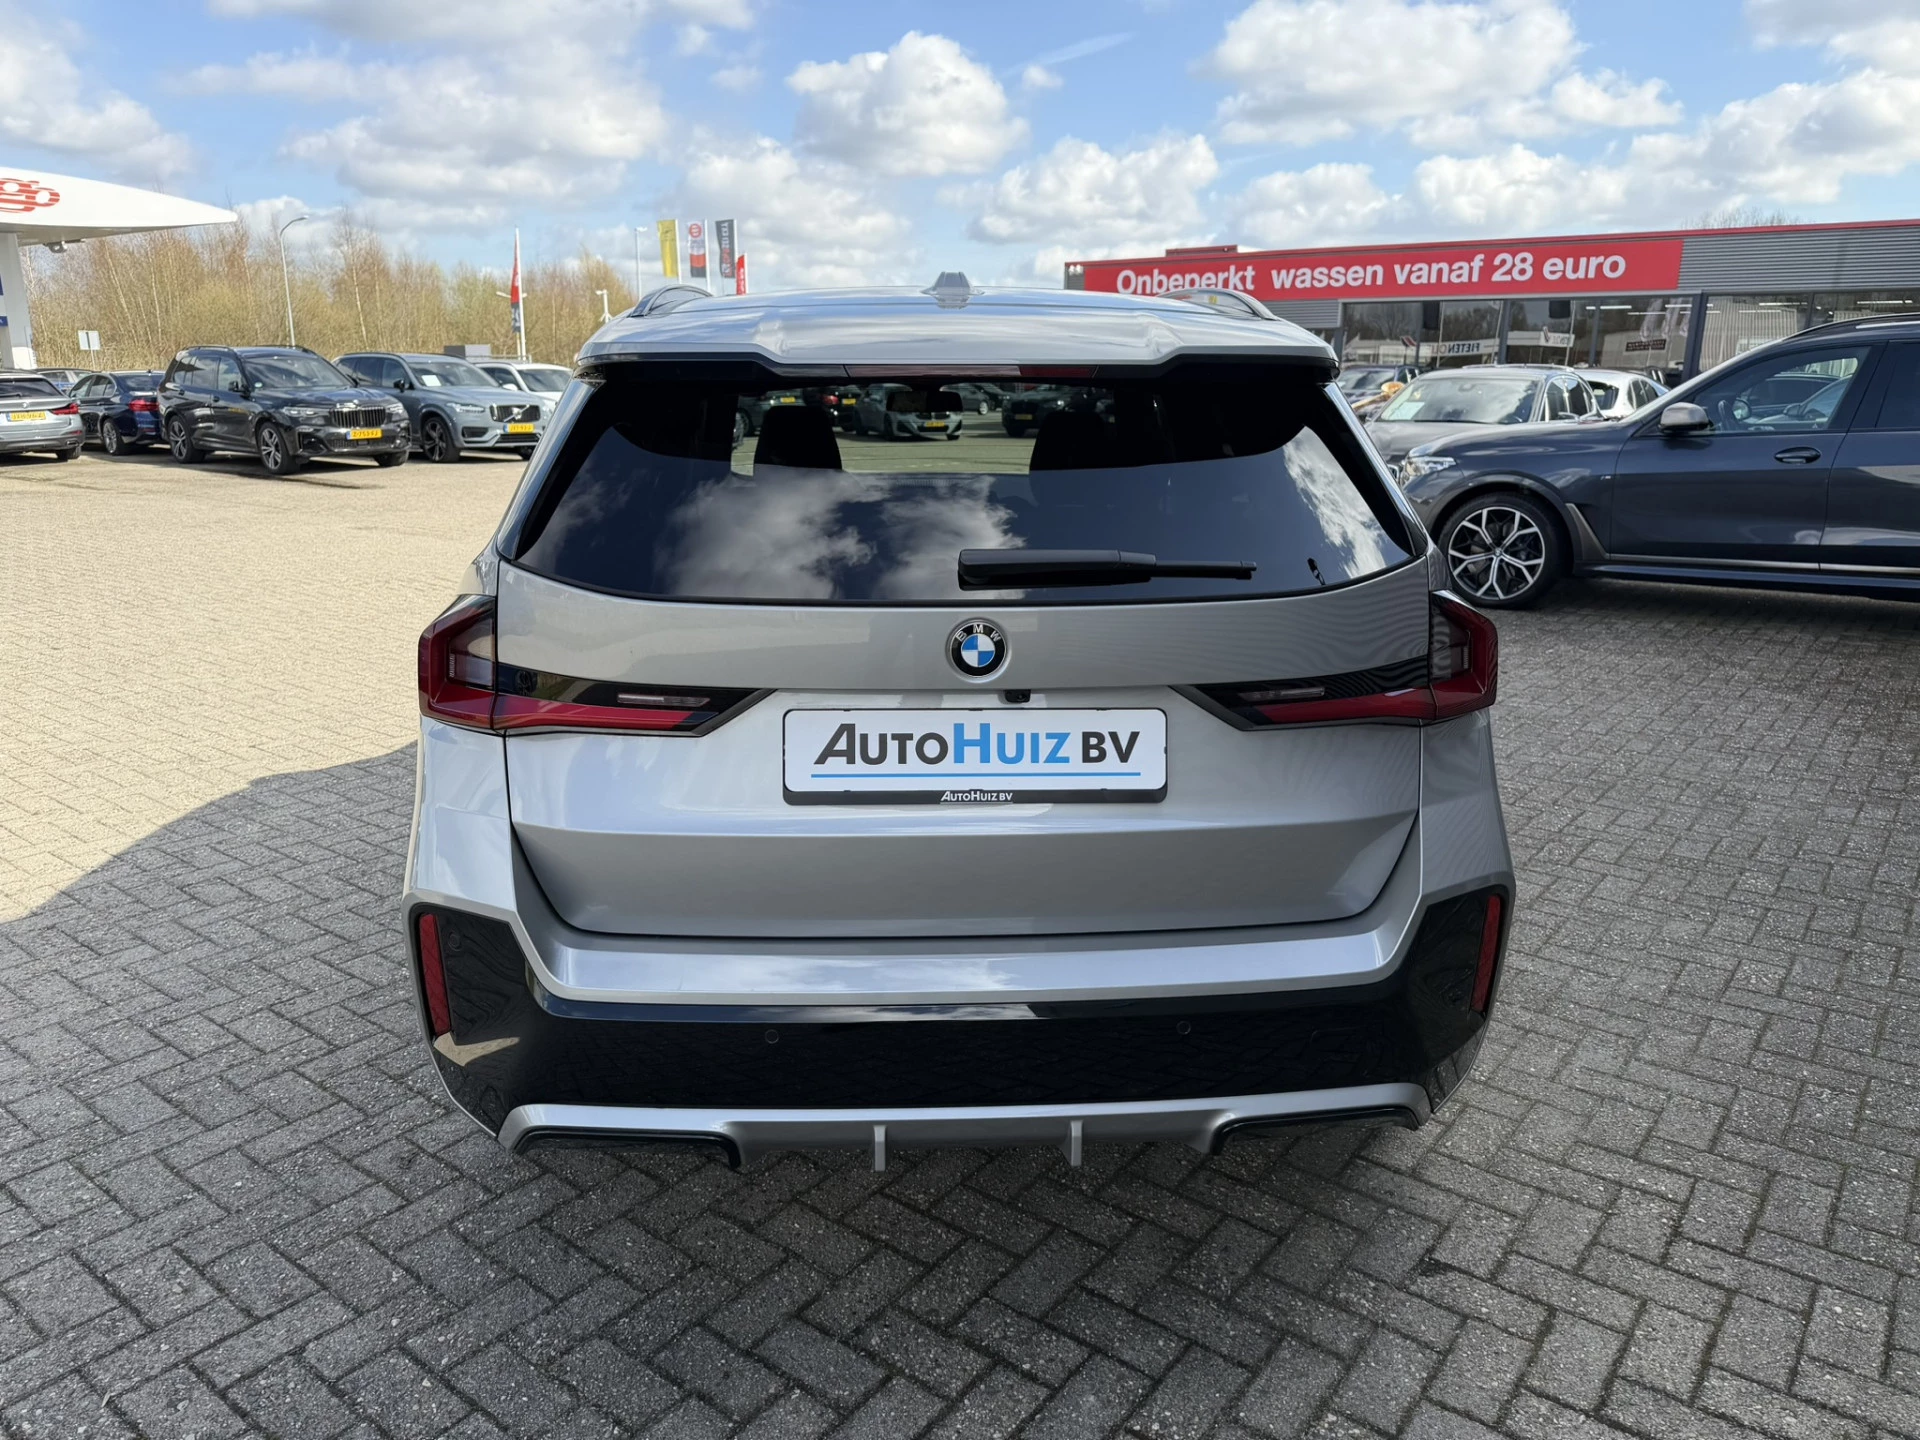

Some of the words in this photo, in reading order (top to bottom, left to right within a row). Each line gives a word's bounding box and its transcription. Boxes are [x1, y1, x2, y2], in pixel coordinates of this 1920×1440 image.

[1117, 265, 1255, 294] Onbeperkt
[1271, 264, 1383, 289] wassen
[1394, 254, 1484, 284] vanaf
[1492, 252, 1534, 281] 28
[1543, 255, 1626, 280] euro
[955, 624, 1001, 642] BMW
[1081, 730, 1141, 764] BV
[999, 792, 1013, 801] BV
